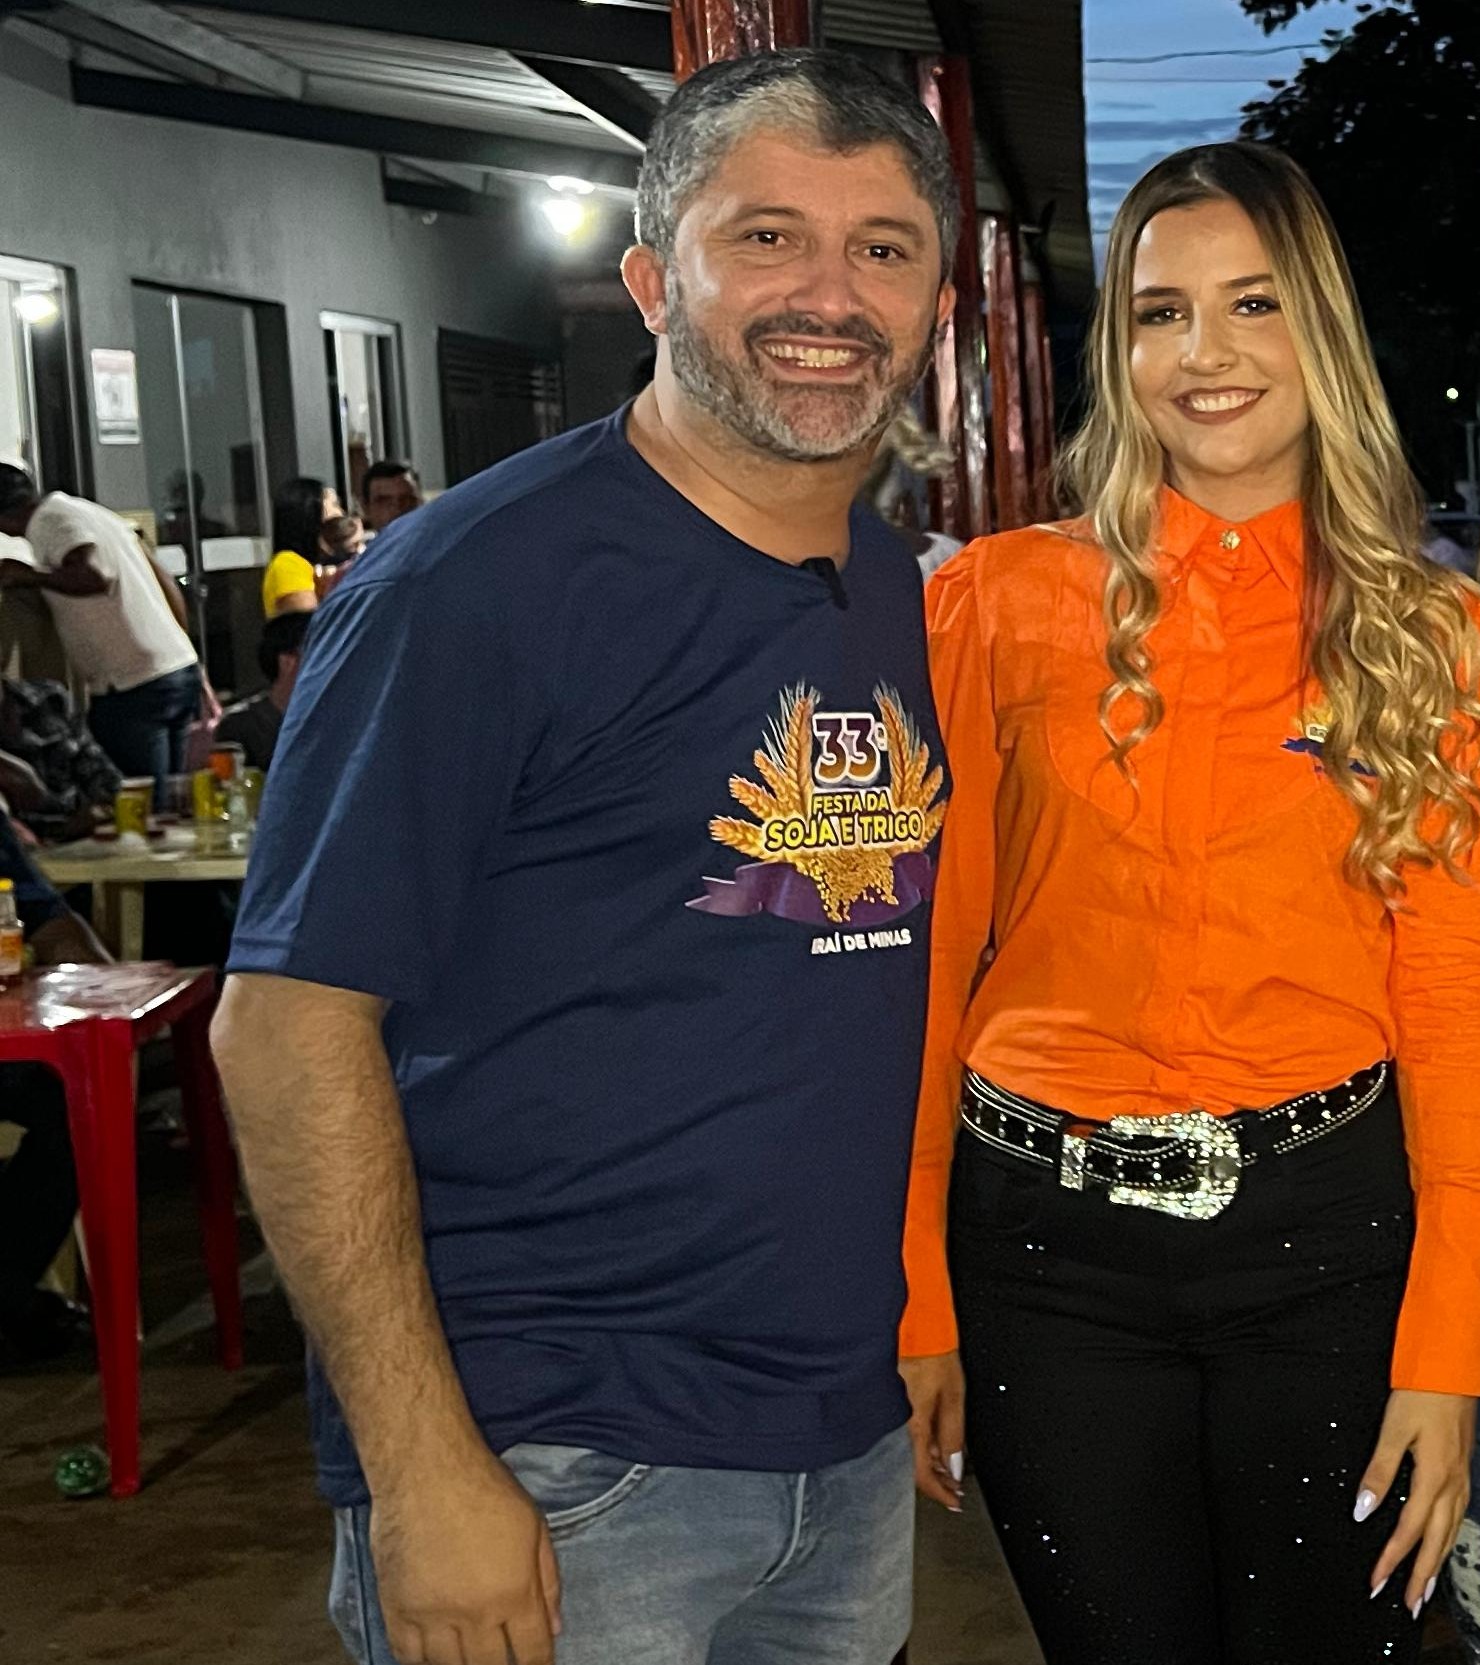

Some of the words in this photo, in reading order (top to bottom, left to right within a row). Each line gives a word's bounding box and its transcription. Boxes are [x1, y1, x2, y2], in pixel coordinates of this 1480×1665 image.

[812, 793, 862, 815] FESTA
[865, 790, 890, 812] DA
[766, 817, 837, 849] SOJA
[840, 816, 854, 844] E
[858, 811, 922, 842] TRIGO
[811, 931, 841, 954] IRAÍ
[843, 933, 868, 951] DE
[868, 928, 912, 948] MINAS
